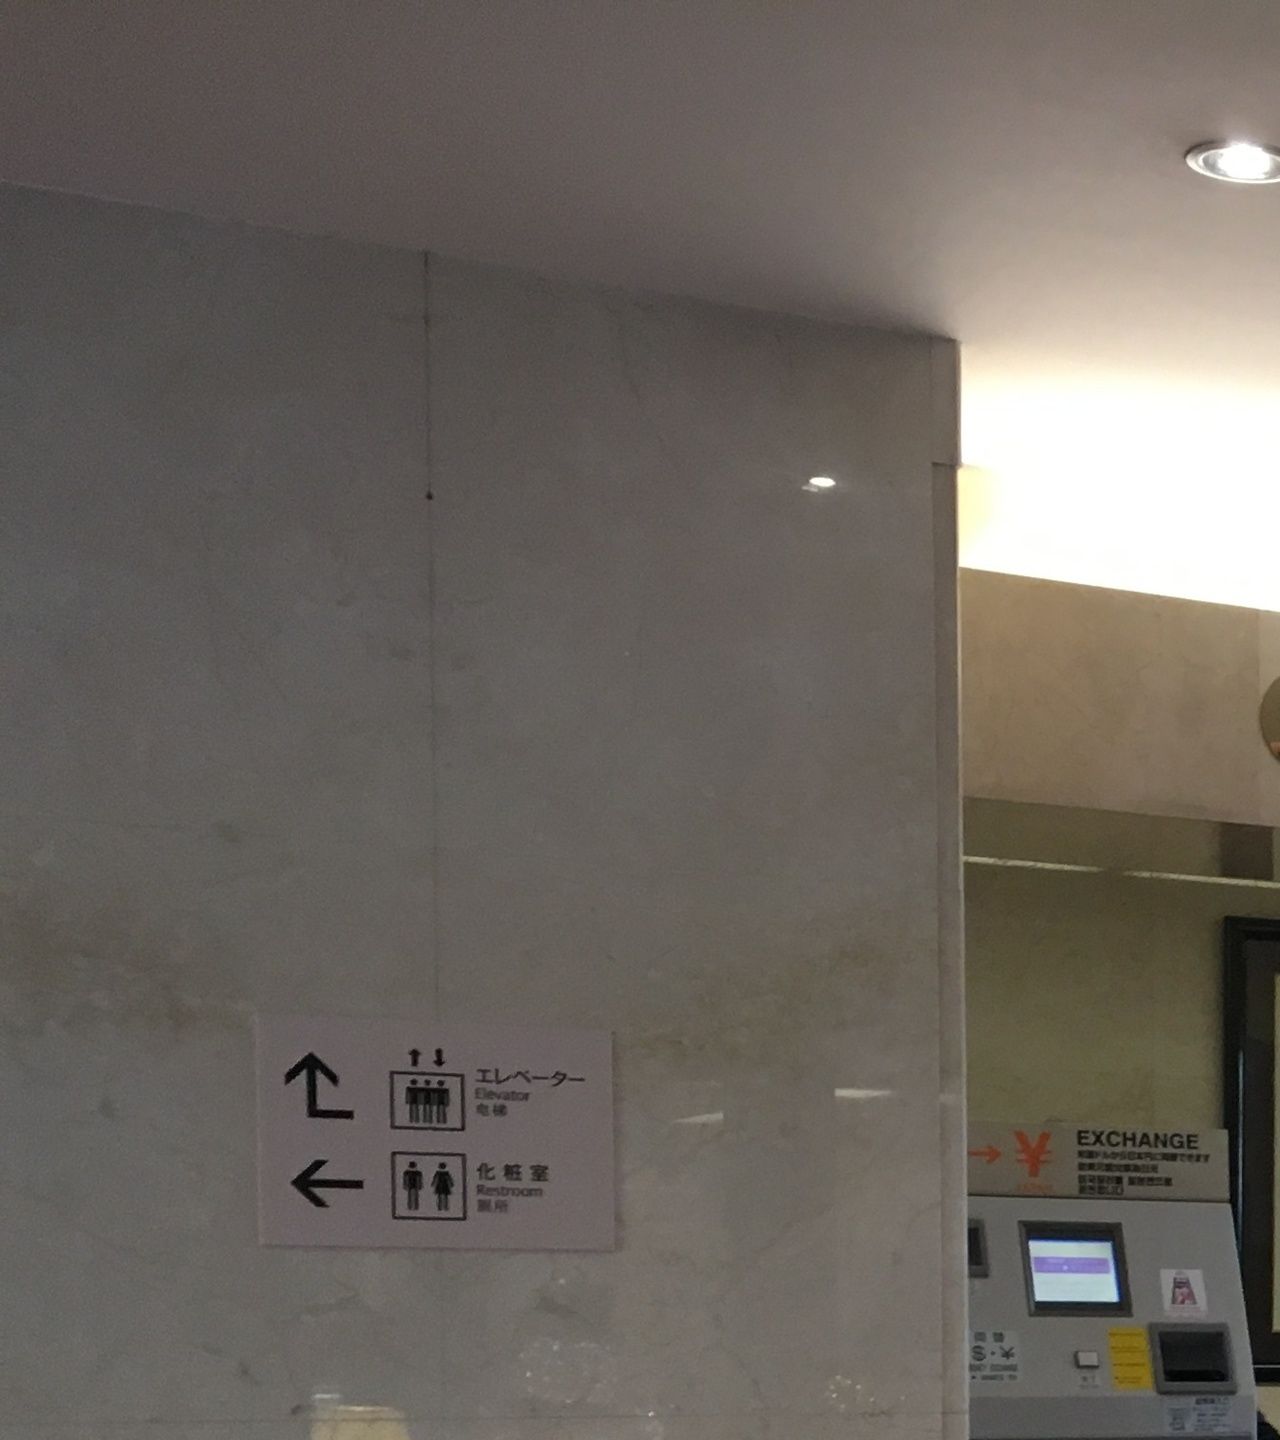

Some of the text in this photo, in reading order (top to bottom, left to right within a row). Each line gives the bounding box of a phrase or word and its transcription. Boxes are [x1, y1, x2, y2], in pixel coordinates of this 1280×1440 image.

[475, 1067, 586, 1088] エレベーター
[474, 1086, 530, 1102] Elevator
[1076, 1129, 1199, 1150] EXCHANGE
[476, 1162, 549, 1182] 化粧室
[476, 1184, 543, 1197] Restroom
